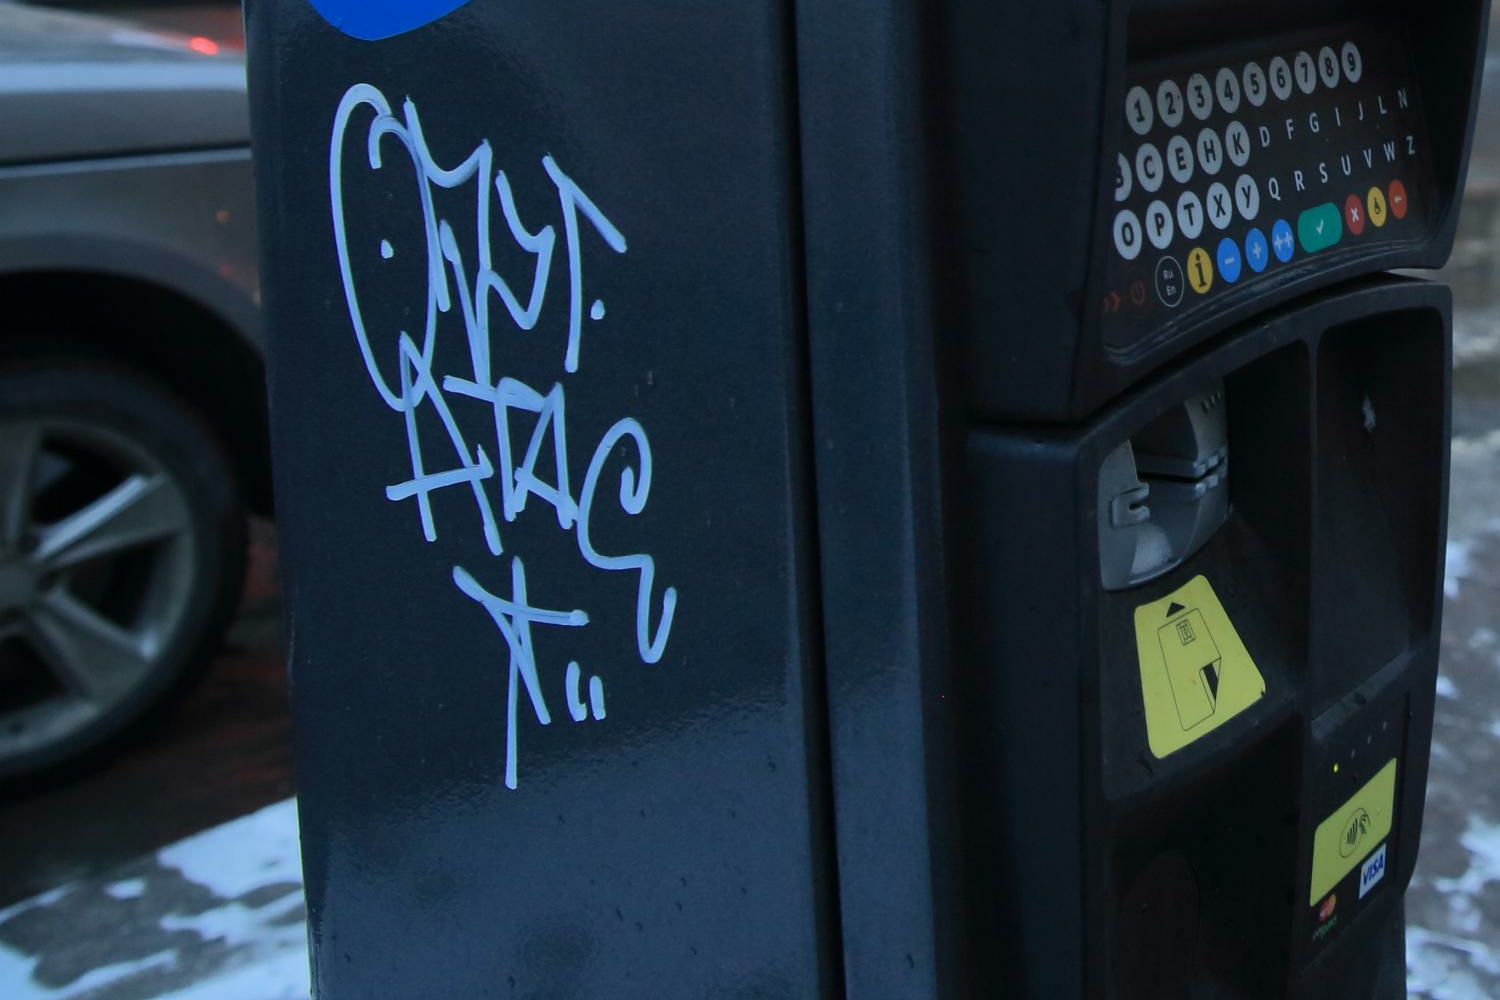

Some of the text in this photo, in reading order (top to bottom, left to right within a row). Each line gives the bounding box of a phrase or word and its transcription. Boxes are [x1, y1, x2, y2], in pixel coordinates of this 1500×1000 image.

[1134, 52, 1356, 122] 1 2 3 4 5 6 7 8 9
[1143, 155, 1155, 179] C
[1175, 147, 1187, 171] E
[1203, 139, 1217, 163] H
[1232, 132, 1245, 156] K
[1259, 126, 1270, 148] D
[1285, 118, 1294, 140] F
[1309, 112, 1320, 133] G
[1378, 96, 1387, 114] L
[1398, 88, 1408, 109] N
[1154, 212, 1165, 237] P
[1183, 202, 1194, 227] T
[1213, 193, 1226, 218] X
[1268, 177, 1281, 201] Q
[1294, 170, 1305, 191] R
[1319, 162, 1328, 183] S
[1341, 155, 1351, 176] U
[1363, 148, 1372, 168] V
[1383, 141, 1395, 162] W
[1406, 135, 1415, 155] Z
[1163, 269, 1173, 280] Ru
[1166, 285, 1176, 296] En
[1363, 853, 1384, 885] VISA
